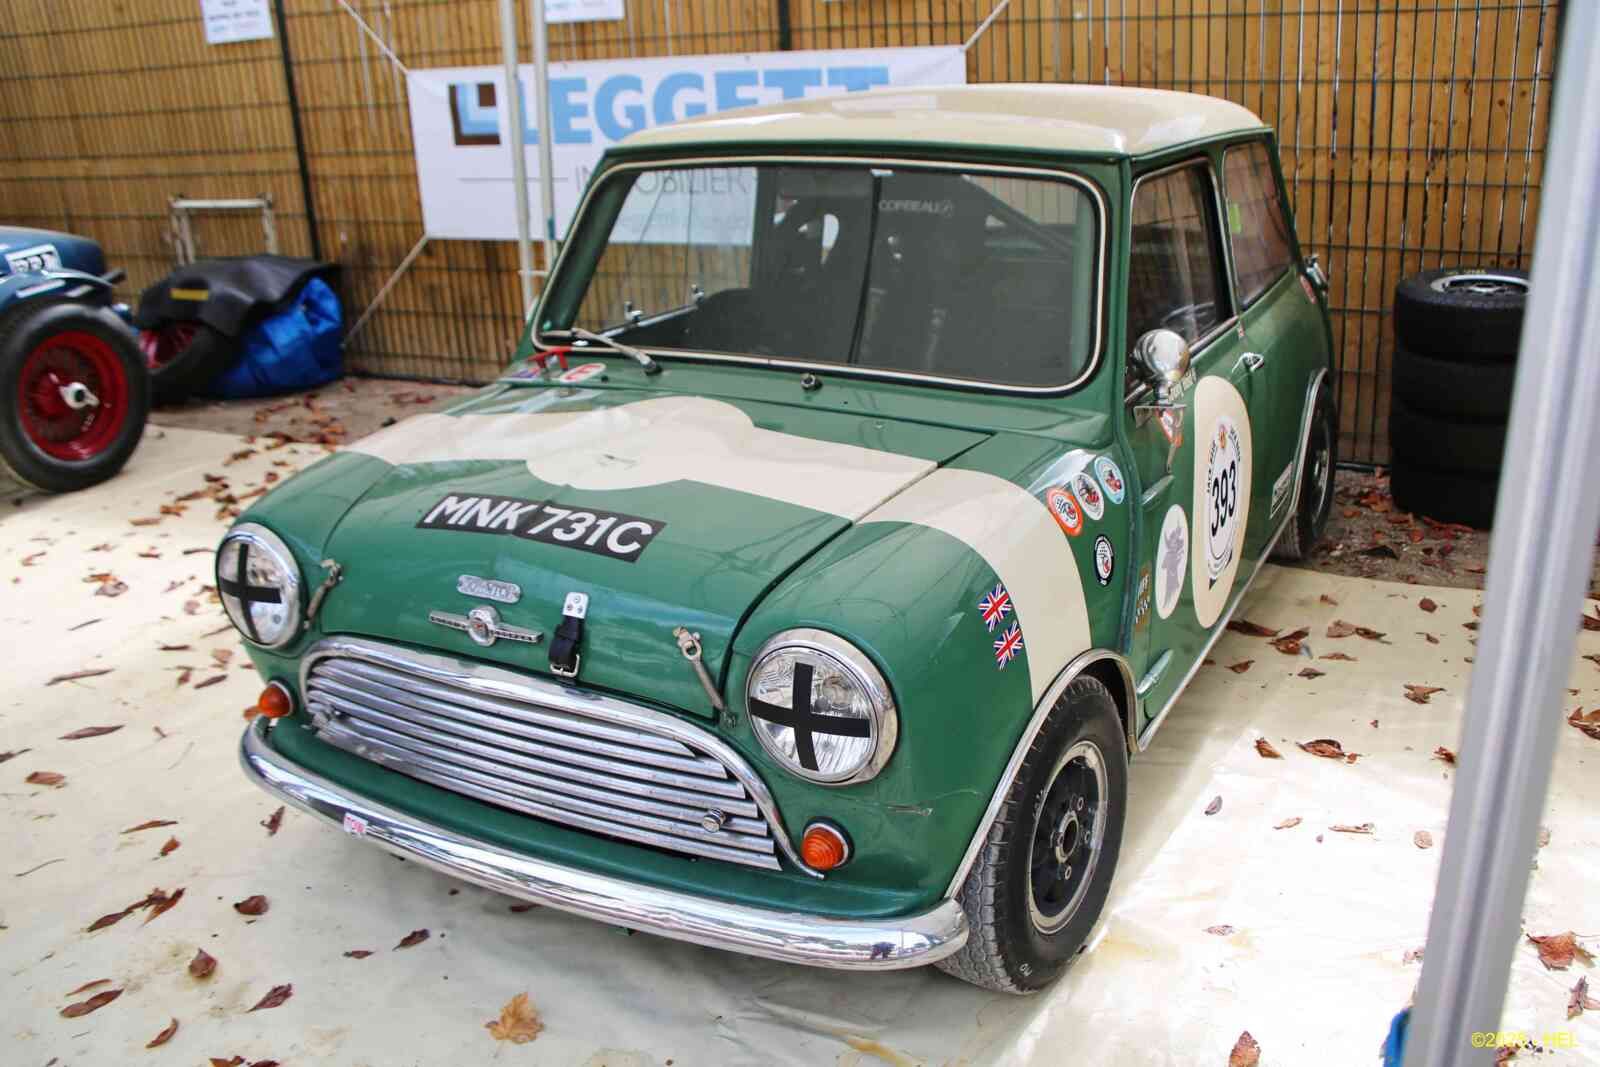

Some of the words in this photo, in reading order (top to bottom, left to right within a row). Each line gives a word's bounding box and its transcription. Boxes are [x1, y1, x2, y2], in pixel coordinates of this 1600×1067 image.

[423, 495, 538, 531] MNK
[527, 506, 653, 554] 731C
[1210, 460, 1237, 537] 393
